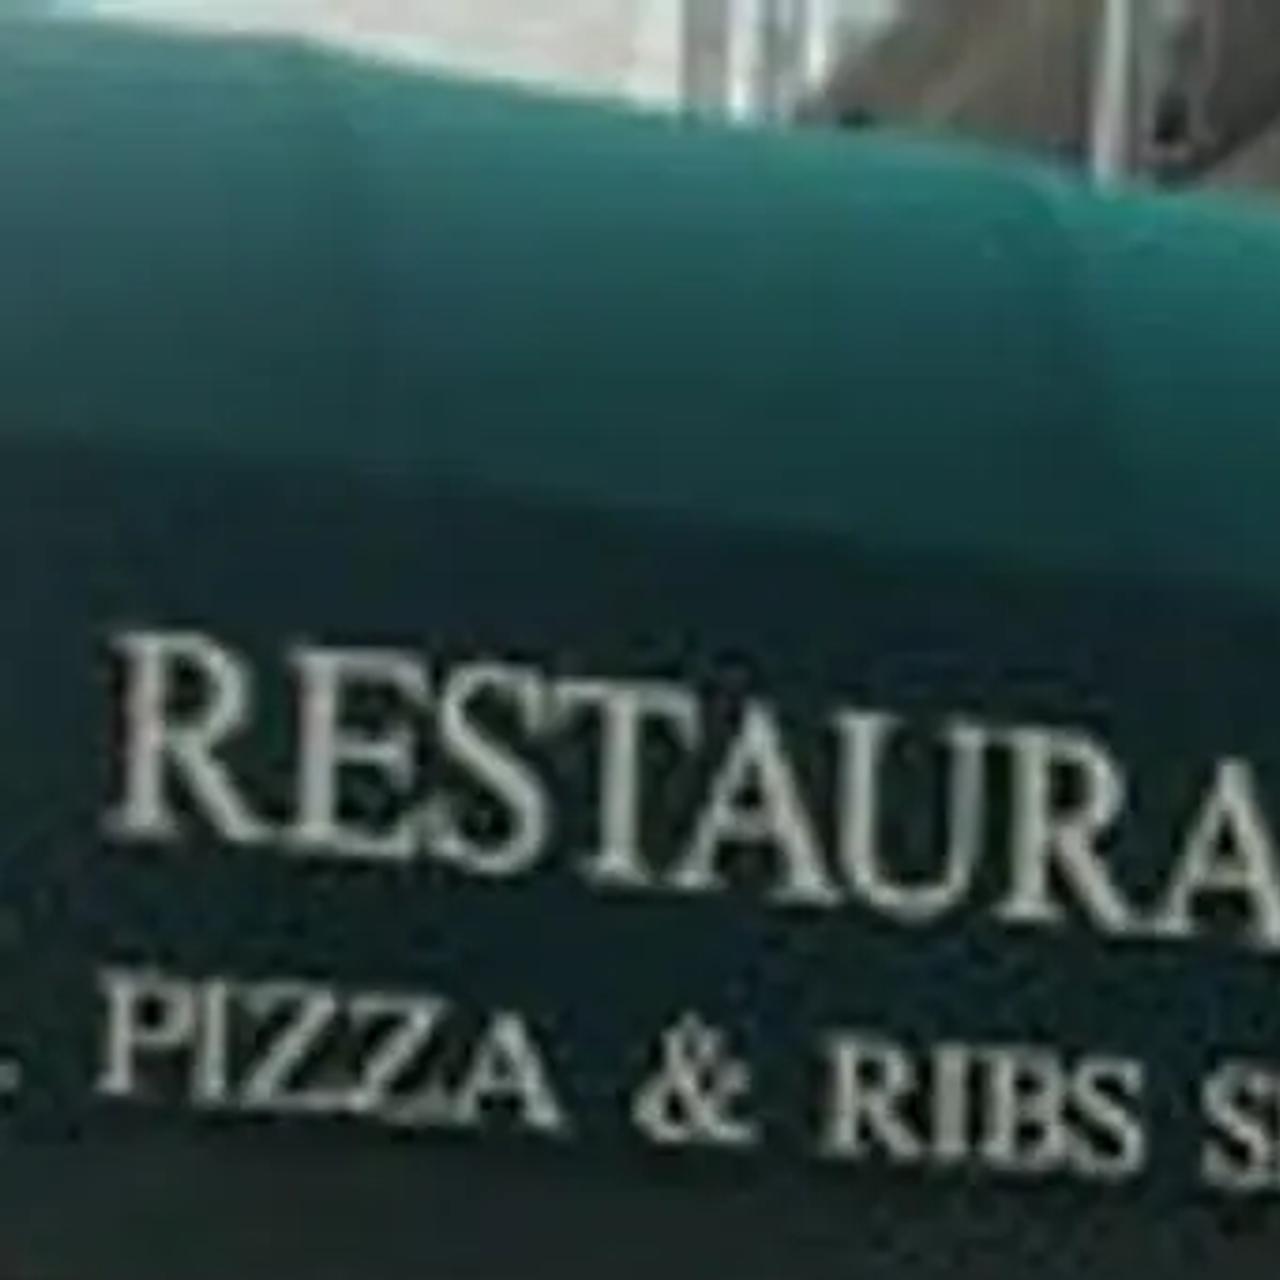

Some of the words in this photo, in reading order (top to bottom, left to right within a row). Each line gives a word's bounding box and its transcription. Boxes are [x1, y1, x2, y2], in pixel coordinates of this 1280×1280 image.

[96, 969, 566, 1132] PIZZA
[630, 1012, 756, 1146] &
[824, 1034, 1147, 1176] RIBS
